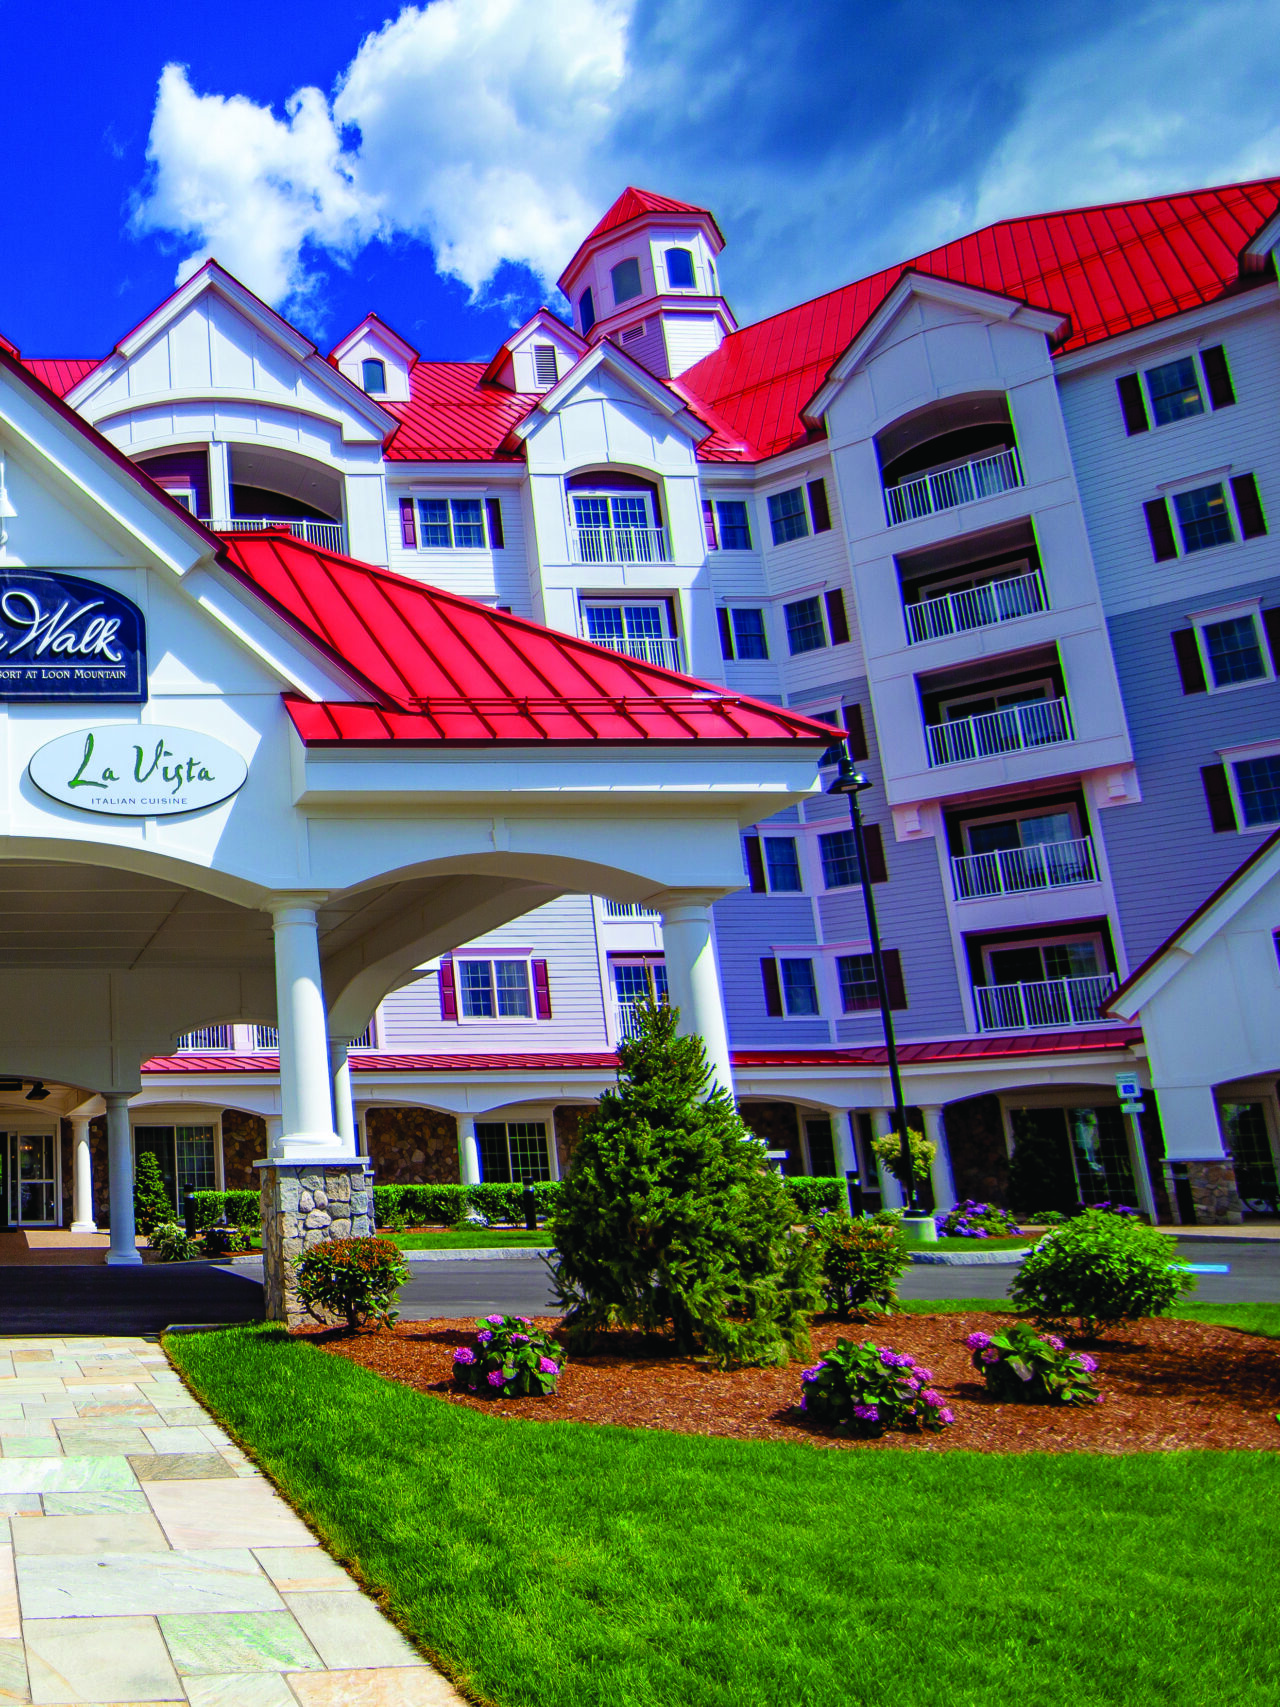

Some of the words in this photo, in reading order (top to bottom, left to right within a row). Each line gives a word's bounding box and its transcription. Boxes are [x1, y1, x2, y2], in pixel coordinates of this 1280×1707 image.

[2, 590, 122, 662] Walk
[67, 732, 120, 789] La
[132, 739, 216, 795] Vista
[91, 797, 136, 805] ITALIAN
[140, 797, 188, 805] CUISINE
